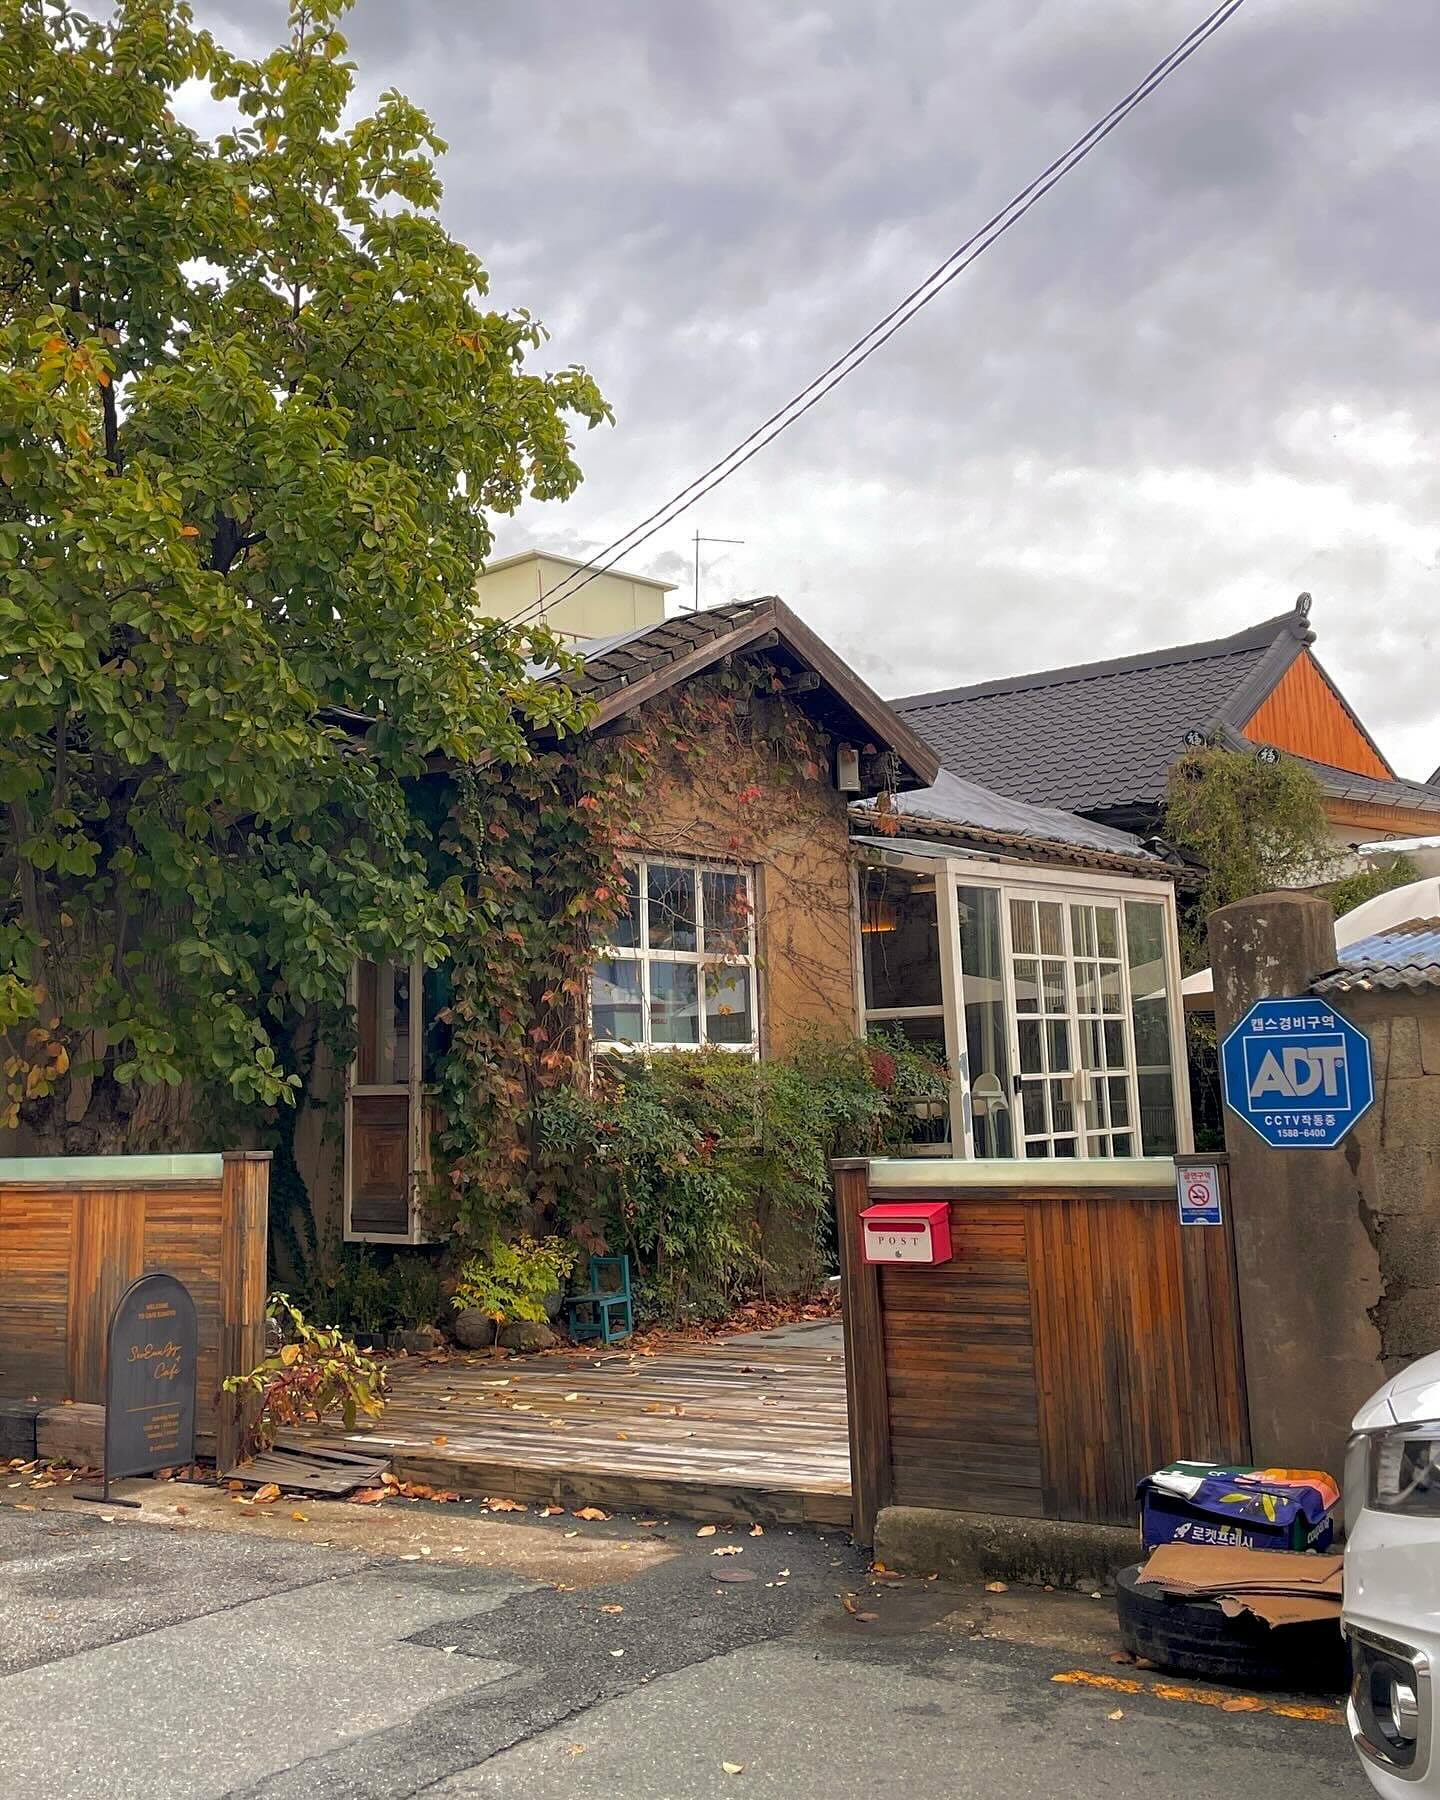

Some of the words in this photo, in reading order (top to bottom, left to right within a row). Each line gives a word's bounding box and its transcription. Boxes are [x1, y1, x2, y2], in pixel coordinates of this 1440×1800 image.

[1251, 1015, 1335, 1031] 캡스경비구역
[1250, 1046, 1345, 1097] ADT
[1277, 1128, 1326, 1138] 1588-6400
[878, 1236, 918, 1246] POST
[1192, 1525, 1254, 1548] 로켓프레시
